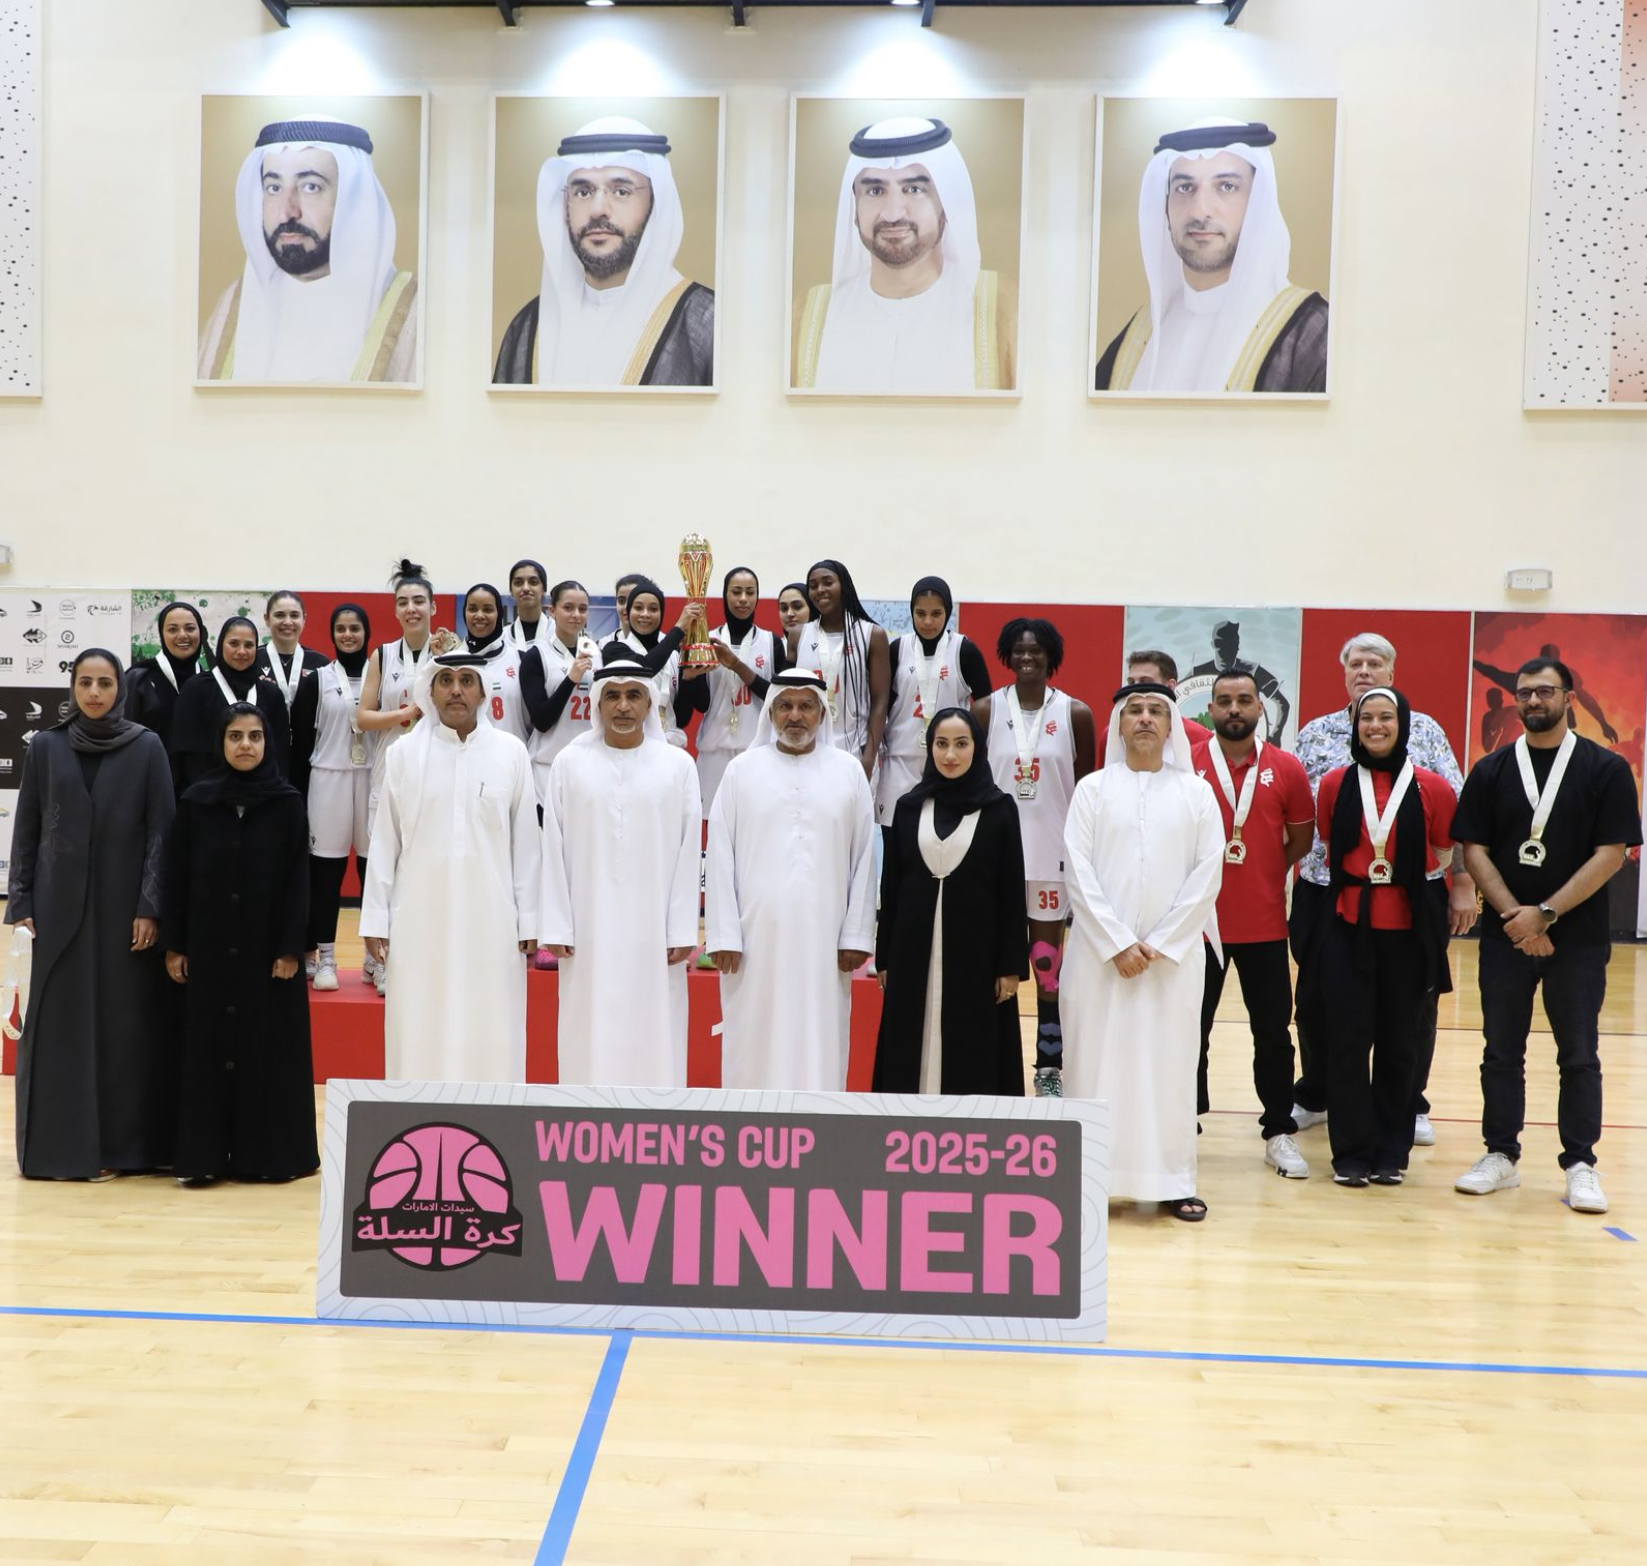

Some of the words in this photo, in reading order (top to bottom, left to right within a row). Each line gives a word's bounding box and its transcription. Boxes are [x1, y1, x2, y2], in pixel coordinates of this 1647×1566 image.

[1182, 677, 1214, 696] لثقافي
[491, 696, 504, 720] 8
[570, 695, 591, 720] 22
[1038, 890, 1059, 910] 35
[737, 1125, 816, 1170] CUP
[885, 1130, 1057, 1177] 2025-26
[440, 1202, 475, 1214] سيدات
[357, 1216, 452, 1240] السلة
[464, 1217, 521, 1248] كرة
[538, 1180, 1063, 1296] WINNER
